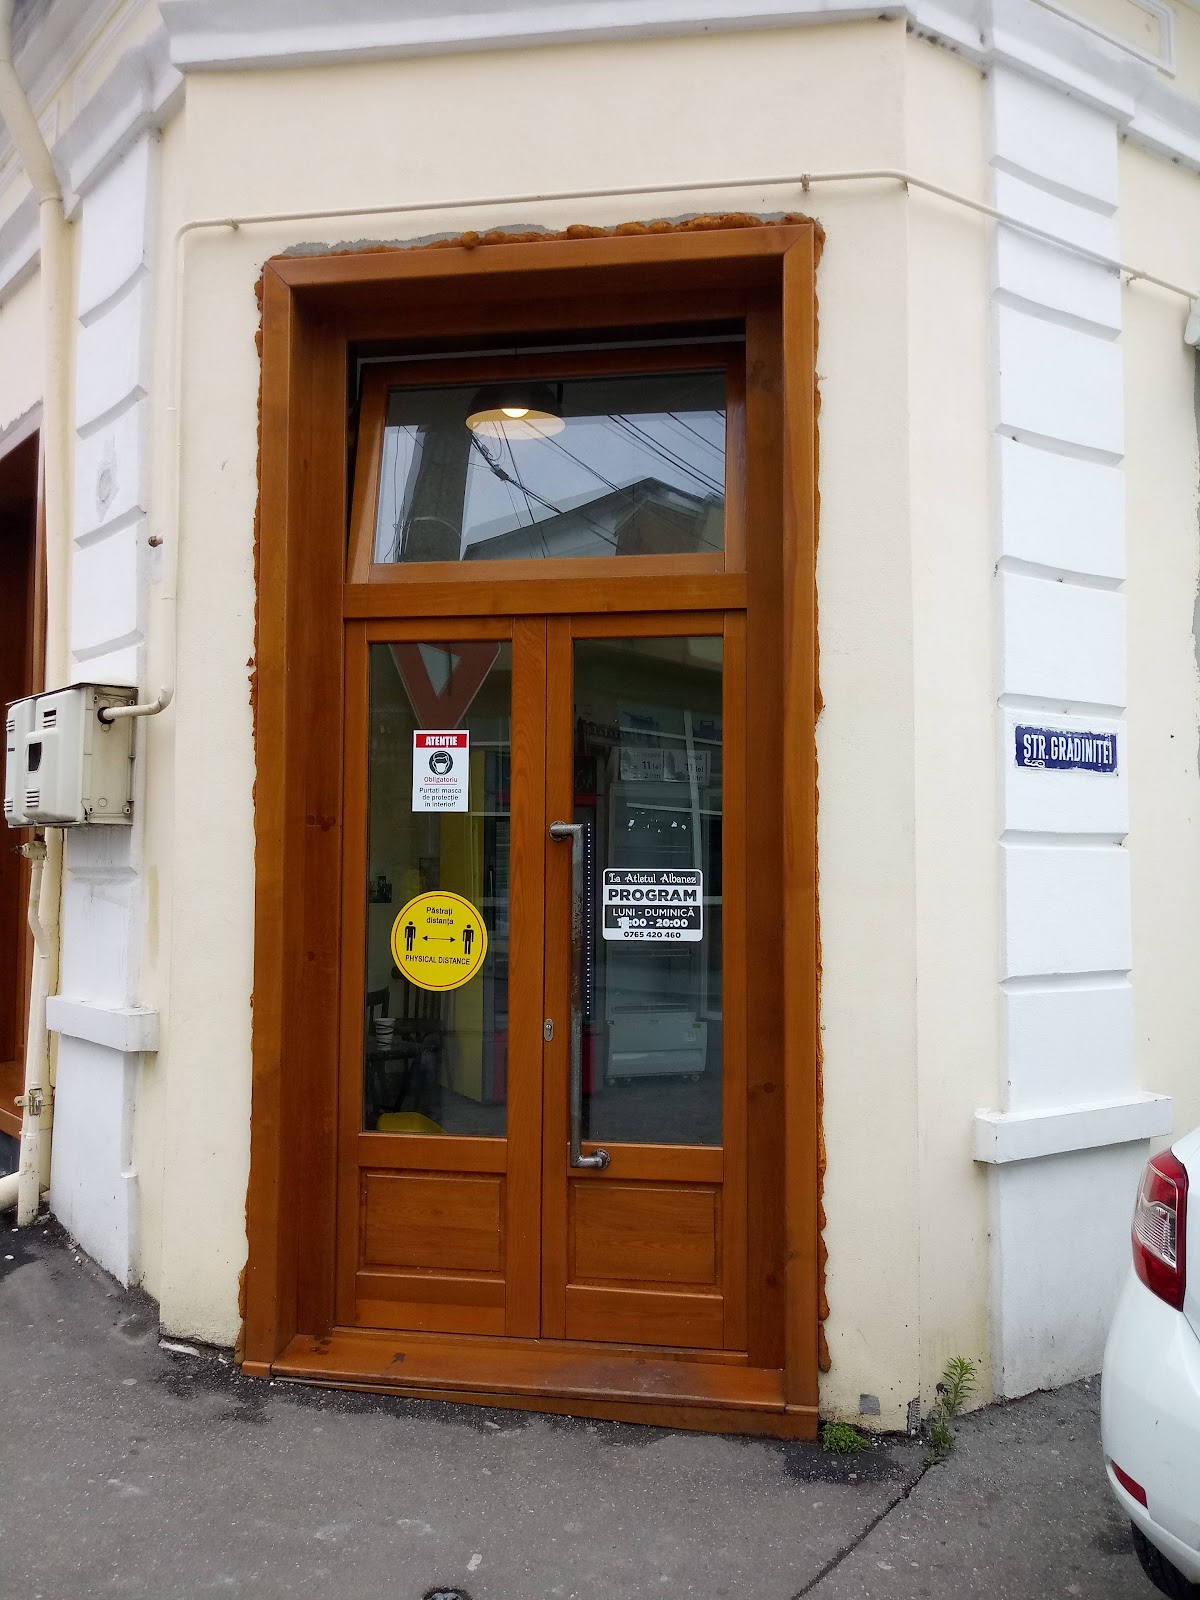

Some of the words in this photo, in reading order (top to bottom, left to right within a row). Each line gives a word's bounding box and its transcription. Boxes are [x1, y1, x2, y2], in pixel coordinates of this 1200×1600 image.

[425, 735, 458, 748] ATENȚIE
[1023, 734, 1049, 760] STR.
[423, 776, 458, 784] Obligatoriu
[608, 872, 621, 883] La
[624, 872, 657, 884] Atletul
[659, 872, 697, 884] Albanez
[608, 888, 697, 902] PROGRAM
[612, 908, 636, 916] LUNI
[644, 907, 695, 917] DUMINICĂ
[616, 917, 647, 927] 1:00
[655, 918, 689, 928] 20:00
[646, 931, 663, 939] 420
[405, 954, 437, 964] PHYSICAL
[438, 956, 471, 966] DISTANCE
